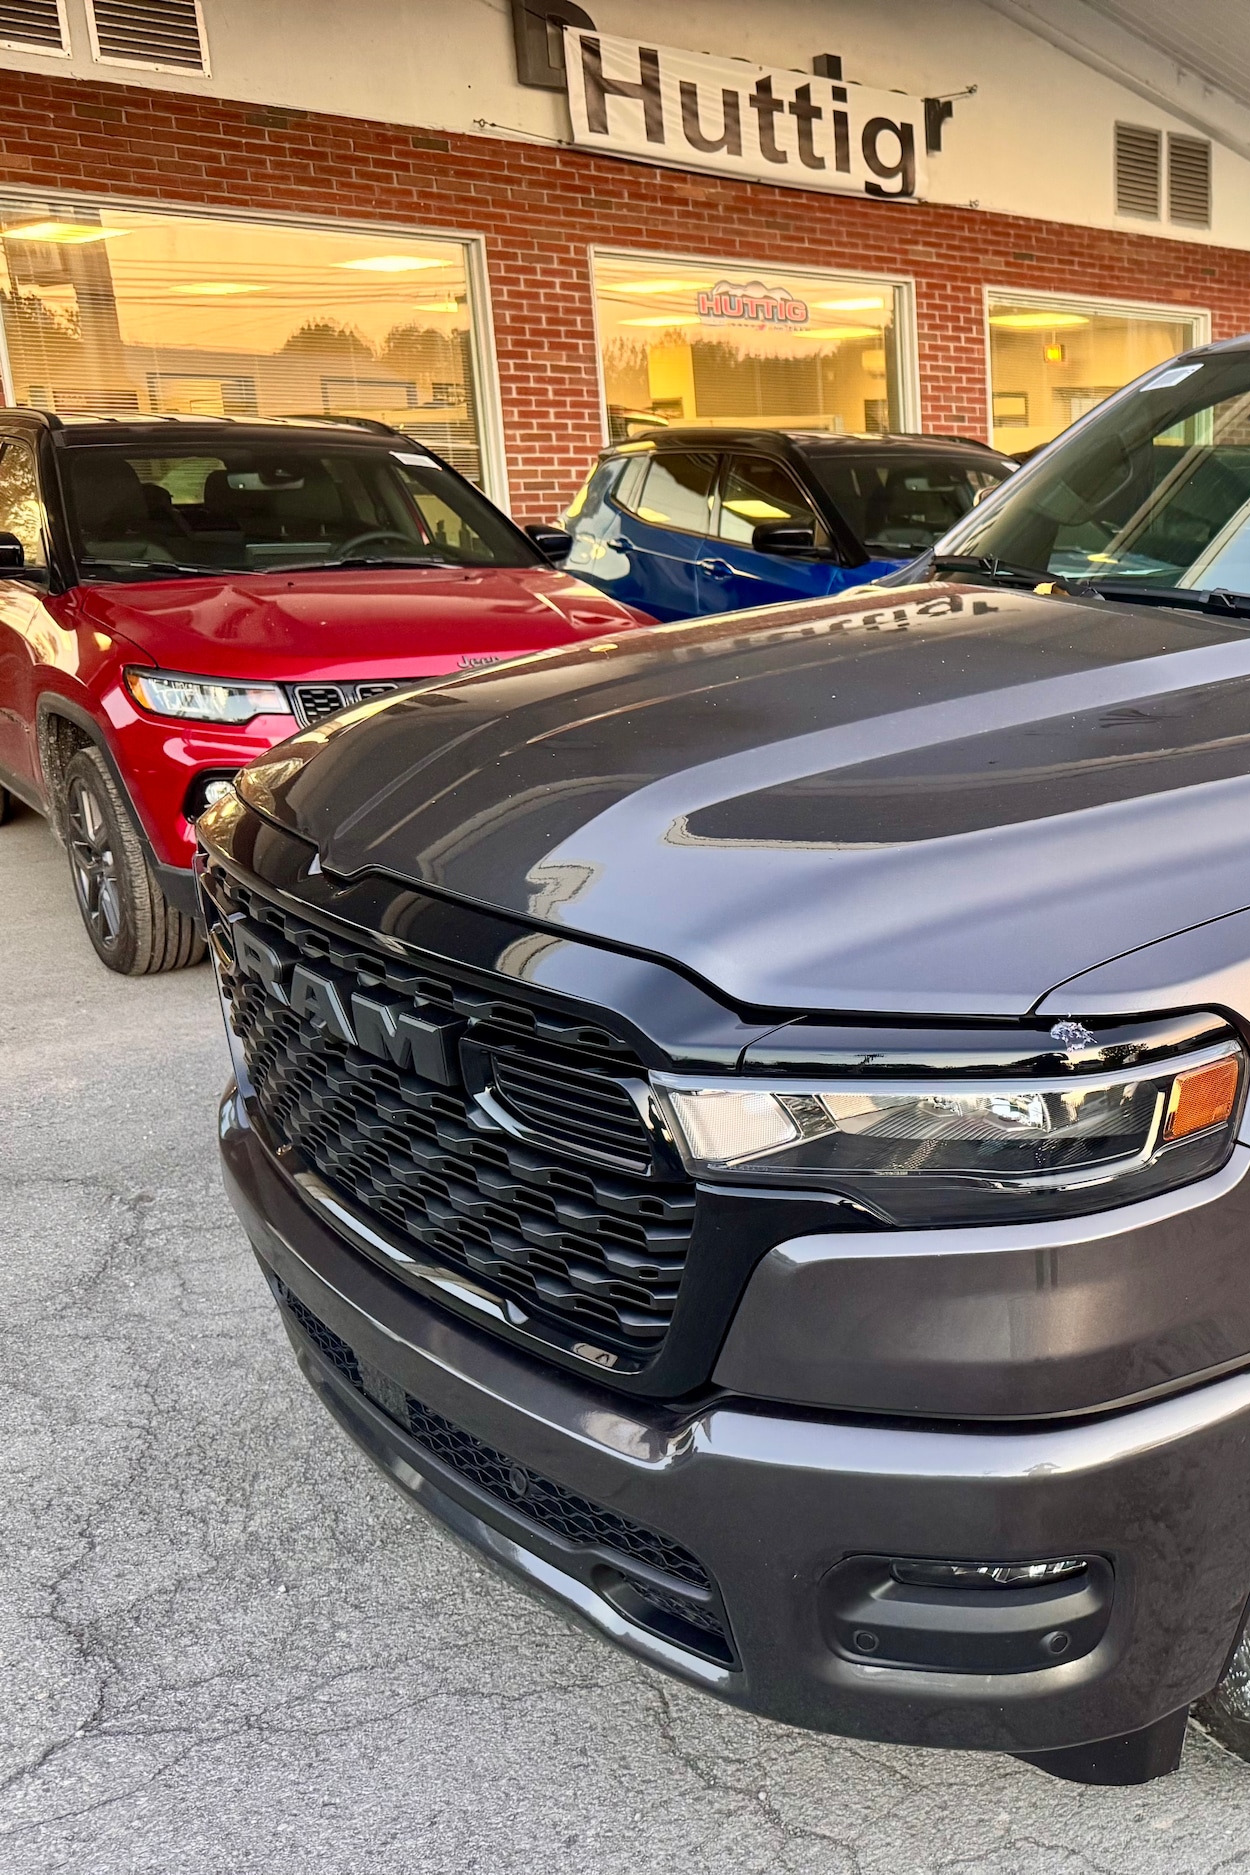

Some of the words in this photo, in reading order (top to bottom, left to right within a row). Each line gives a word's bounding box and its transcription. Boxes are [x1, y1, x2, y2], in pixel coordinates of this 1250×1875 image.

[580, 35, 915, 197] Huttig
[698, 292, 809, 323] HUTTIG
[232, 915, 460, 1087] RAM
